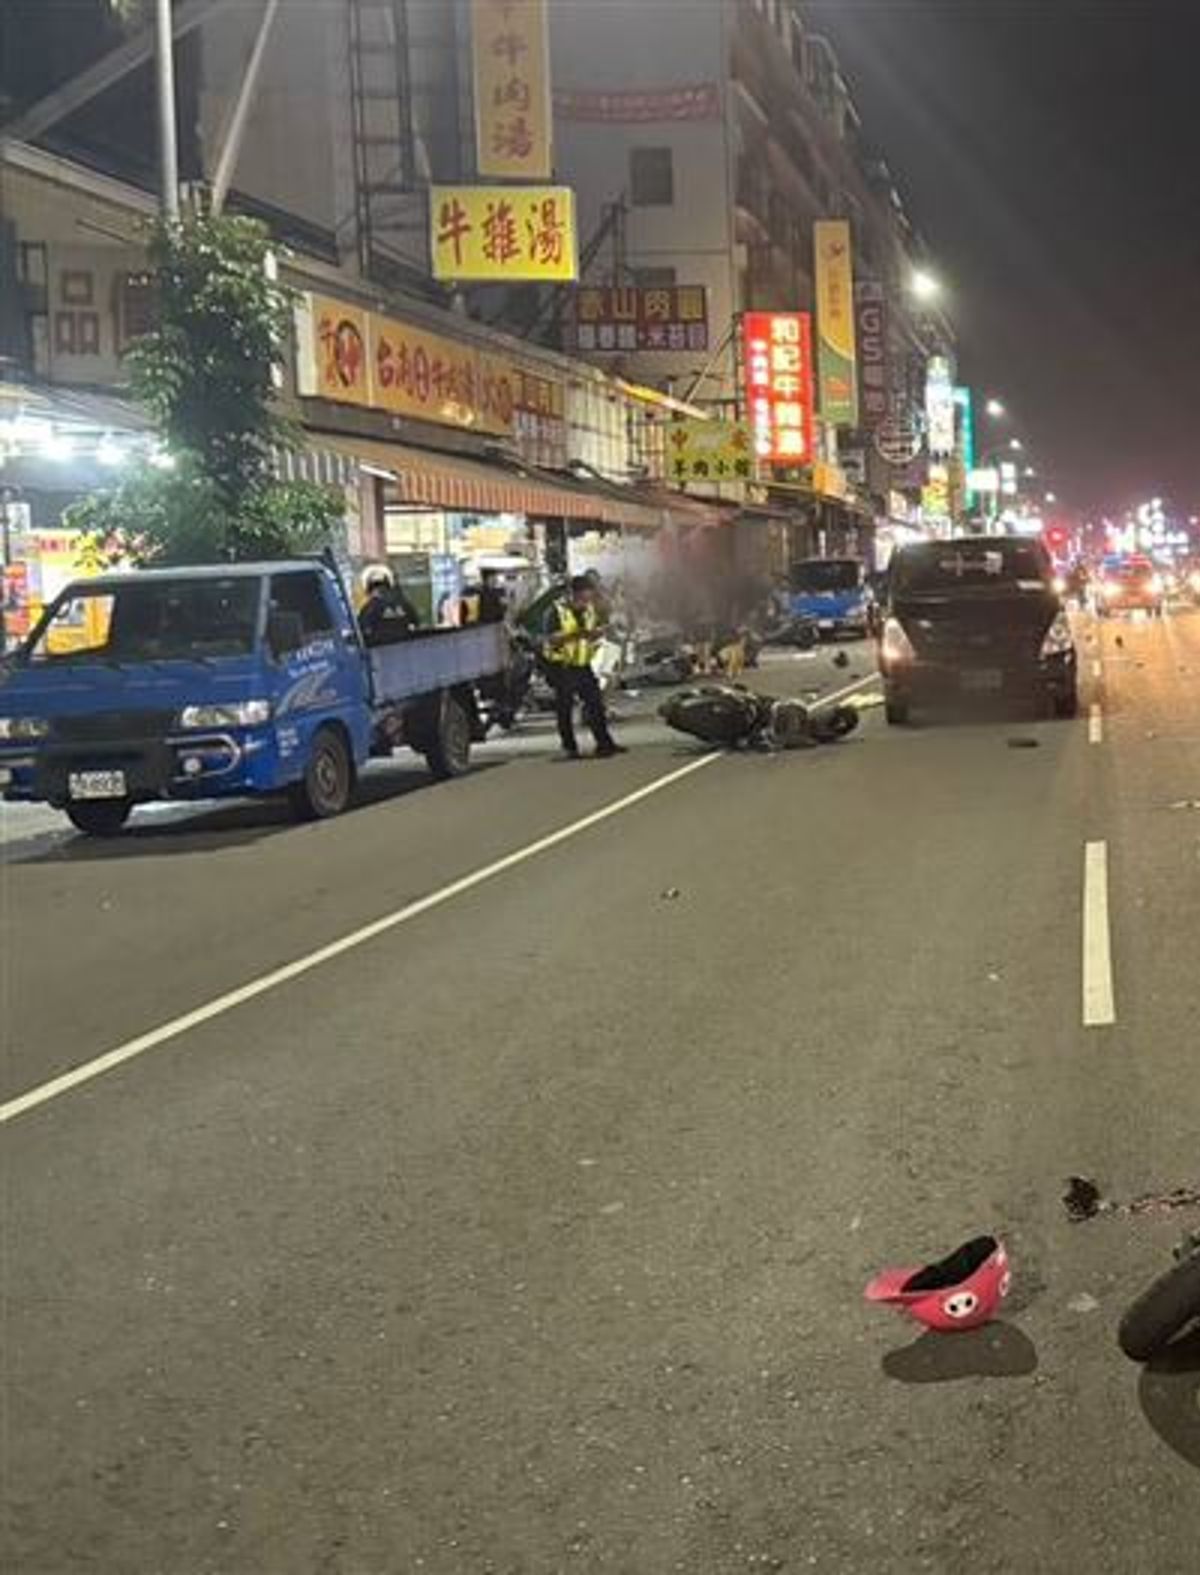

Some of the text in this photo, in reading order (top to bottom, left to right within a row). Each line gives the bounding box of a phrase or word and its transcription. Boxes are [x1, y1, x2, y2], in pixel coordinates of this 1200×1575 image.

[491, 0, 535, 160] 牛肉湯
[437, 197, 567, 267] 牛雜湯
